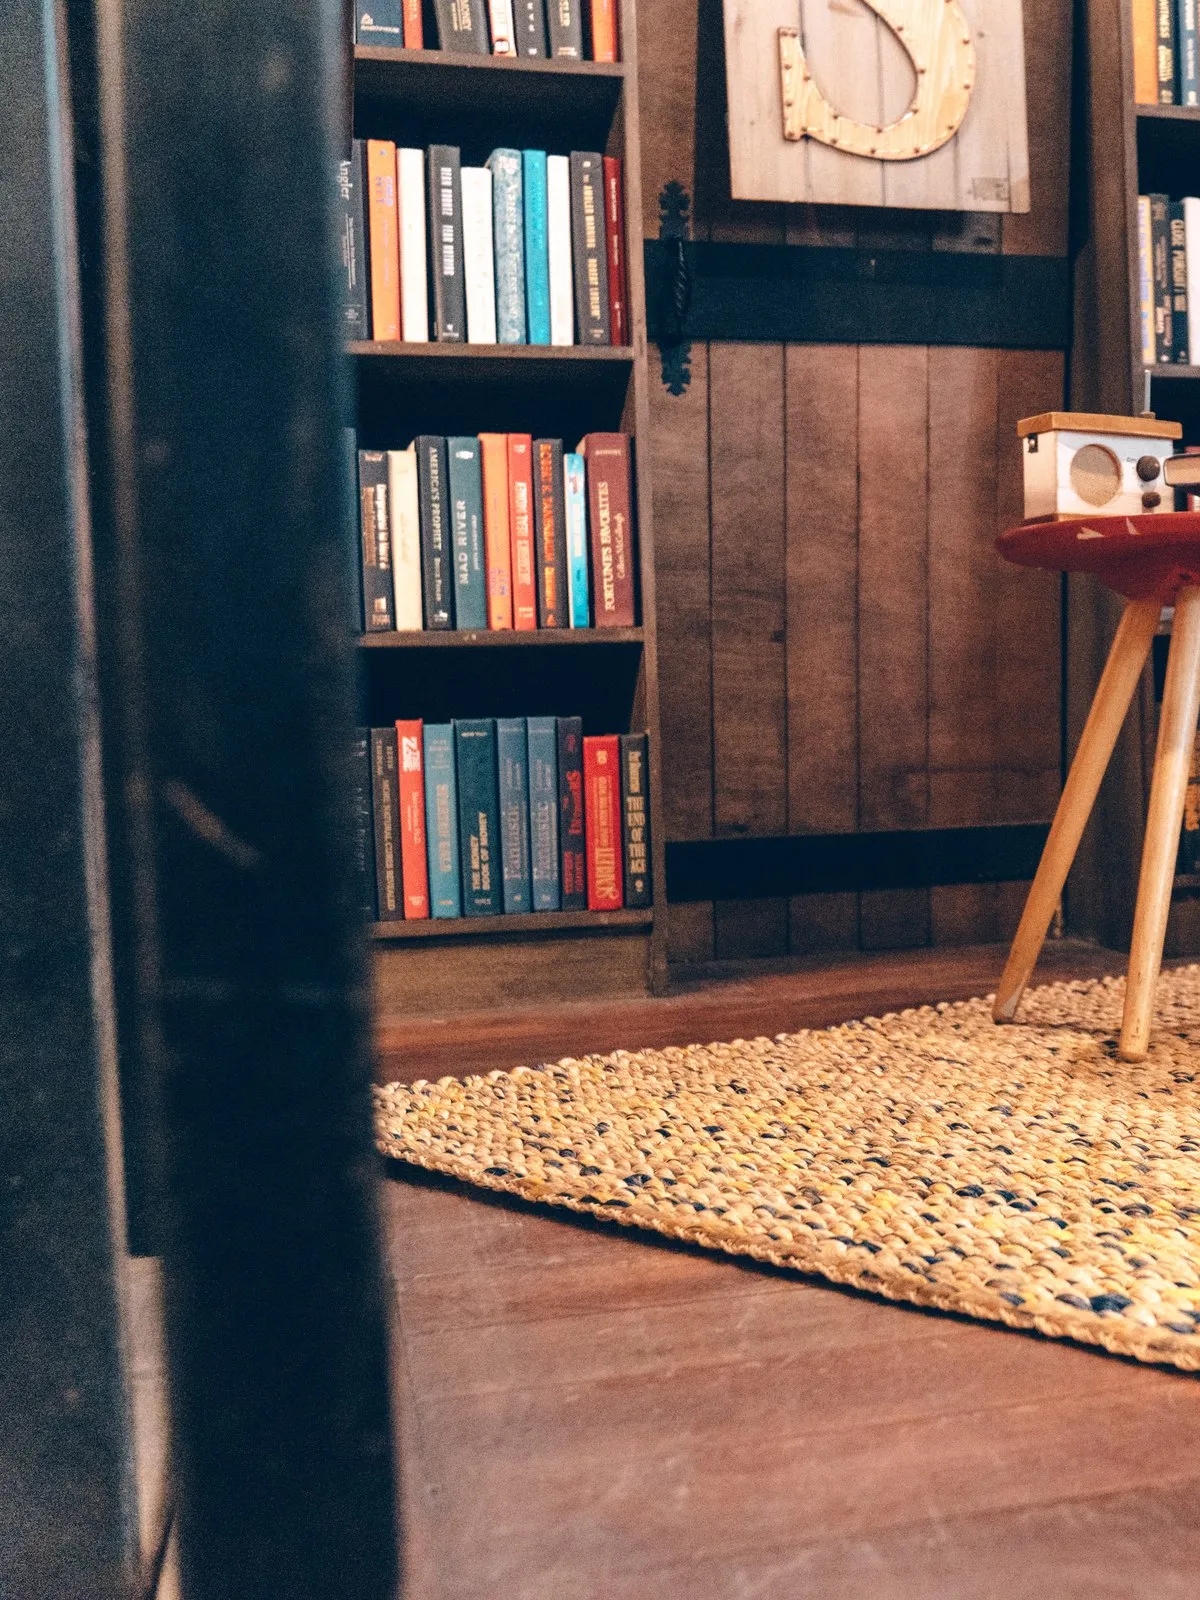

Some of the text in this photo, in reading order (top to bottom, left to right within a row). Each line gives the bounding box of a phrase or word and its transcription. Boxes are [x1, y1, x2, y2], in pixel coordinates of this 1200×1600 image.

[337, 160, 354, 200] Angler
[432, 502, 443, 550] PROPHET
[456, 501, 470, 585] MAD RIVER
